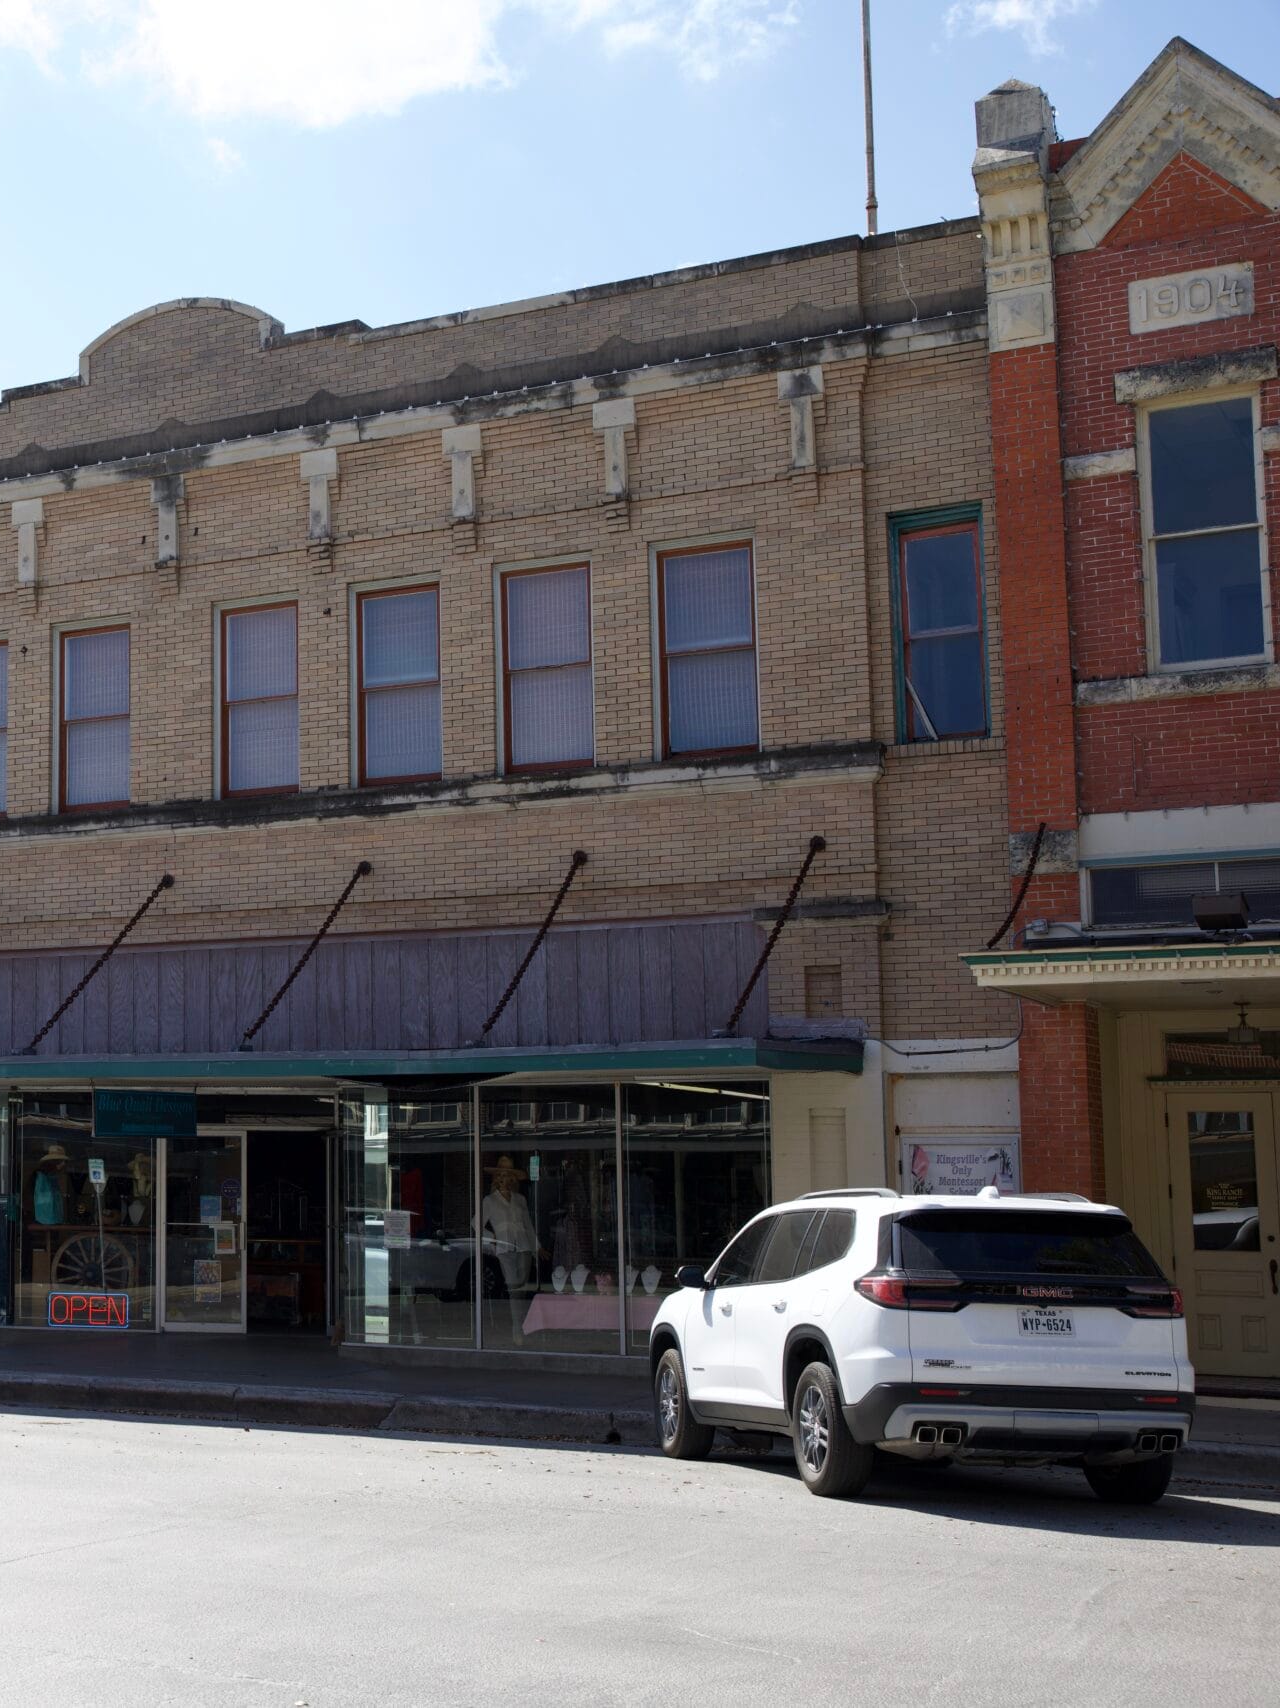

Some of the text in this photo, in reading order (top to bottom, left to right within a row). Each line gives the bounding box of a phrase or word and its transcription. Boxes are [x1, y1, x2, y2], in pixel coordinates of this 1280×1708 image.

[1138, 275, 1244, 323] 1904
[936, 1154, 986, 1166] Kingsville's
[952, 1166, 972, 1177] Only
[938, 1177, 986, 1186] Montessori
[1206, 1187, 1243, 1196] KING RANCH
[1022, 1287, 1074, 1298] GMC
[51, 1295, 125, 1325] OPEN
